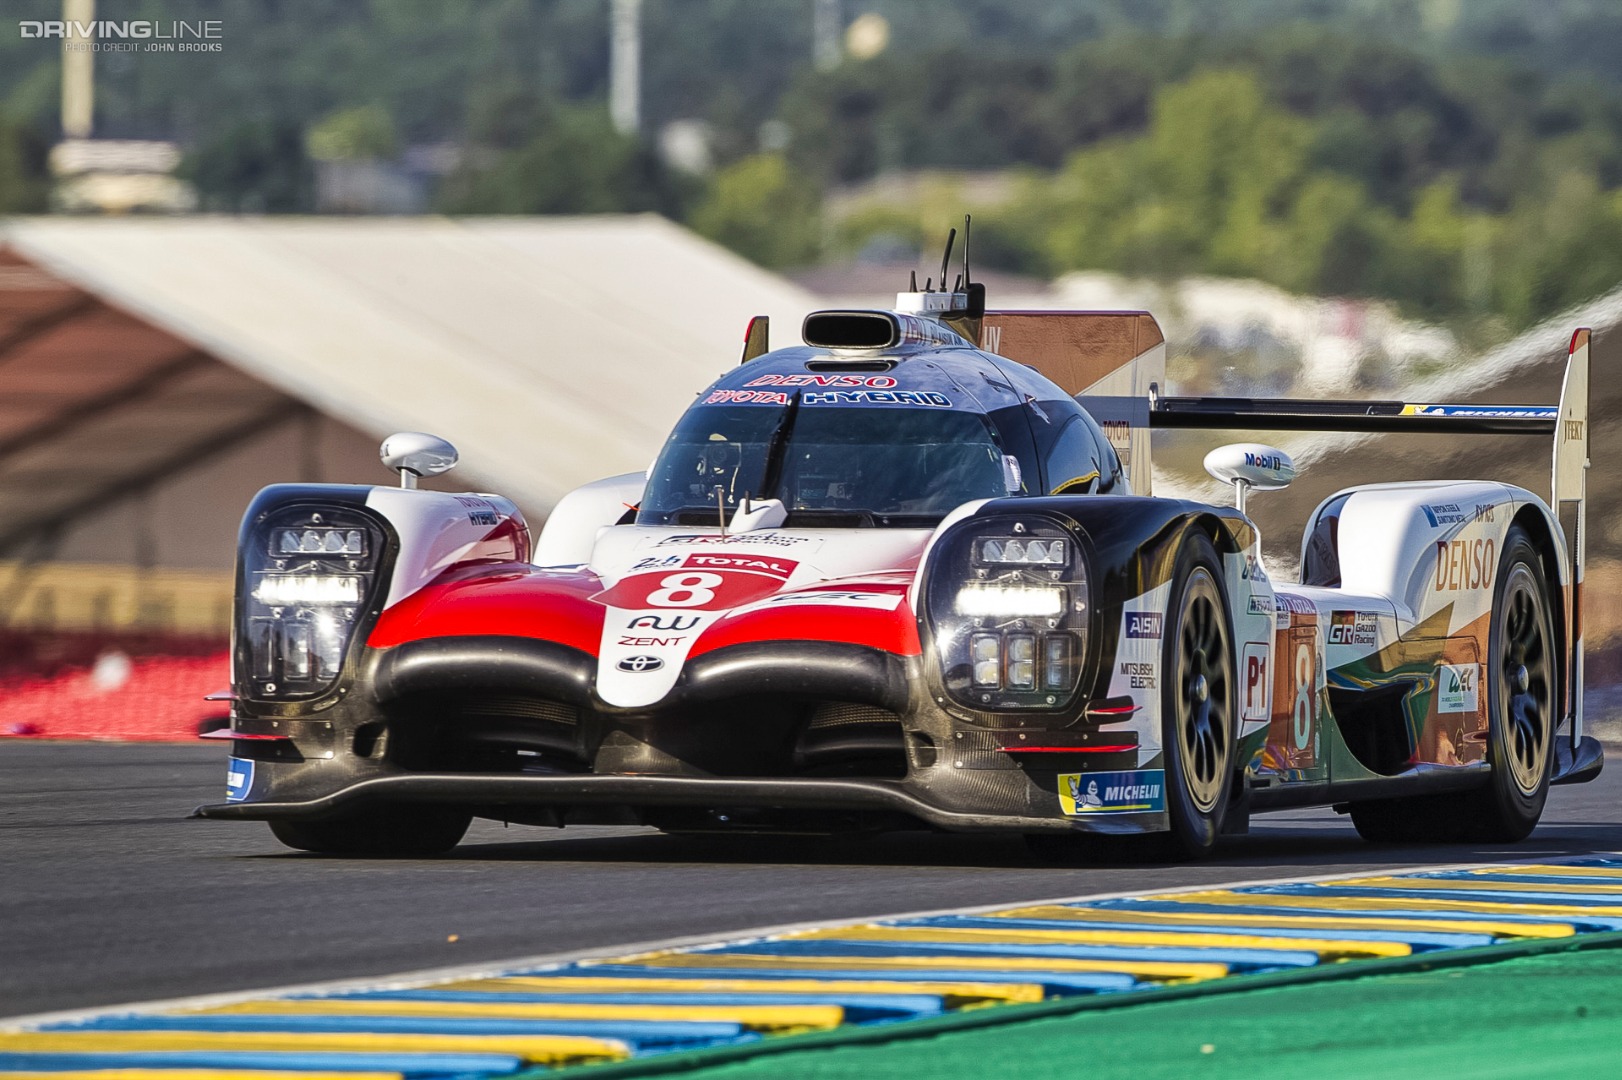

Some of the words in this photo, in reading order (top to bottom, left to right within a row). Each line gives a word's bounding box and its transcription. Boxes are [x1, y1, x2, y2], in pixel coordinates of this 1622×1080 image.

[743, 374, 897, 389] DENSO
[701, 389, 787, 405] TOYOTA
[803, 391, 953, 408] HYBRID
[1245, 452, 1273, 469] Mobil
[691, 556, 789, 573] TOTAL
[1436, 538, 1494, 591] DENSO
[646, 572, 723, 607] 8
[1130, 616, 1161, 634] AISIN
[1330, 624, 1354, 643] GR
[617, 635, 687, 647] ZENT
[1354, 634, 1375, 648] Racing
[1247, 654, 1267, 708] P1
[1294, 643, 1312, 751] 8
[1104, 783, 1161, 801] MICHELIN
